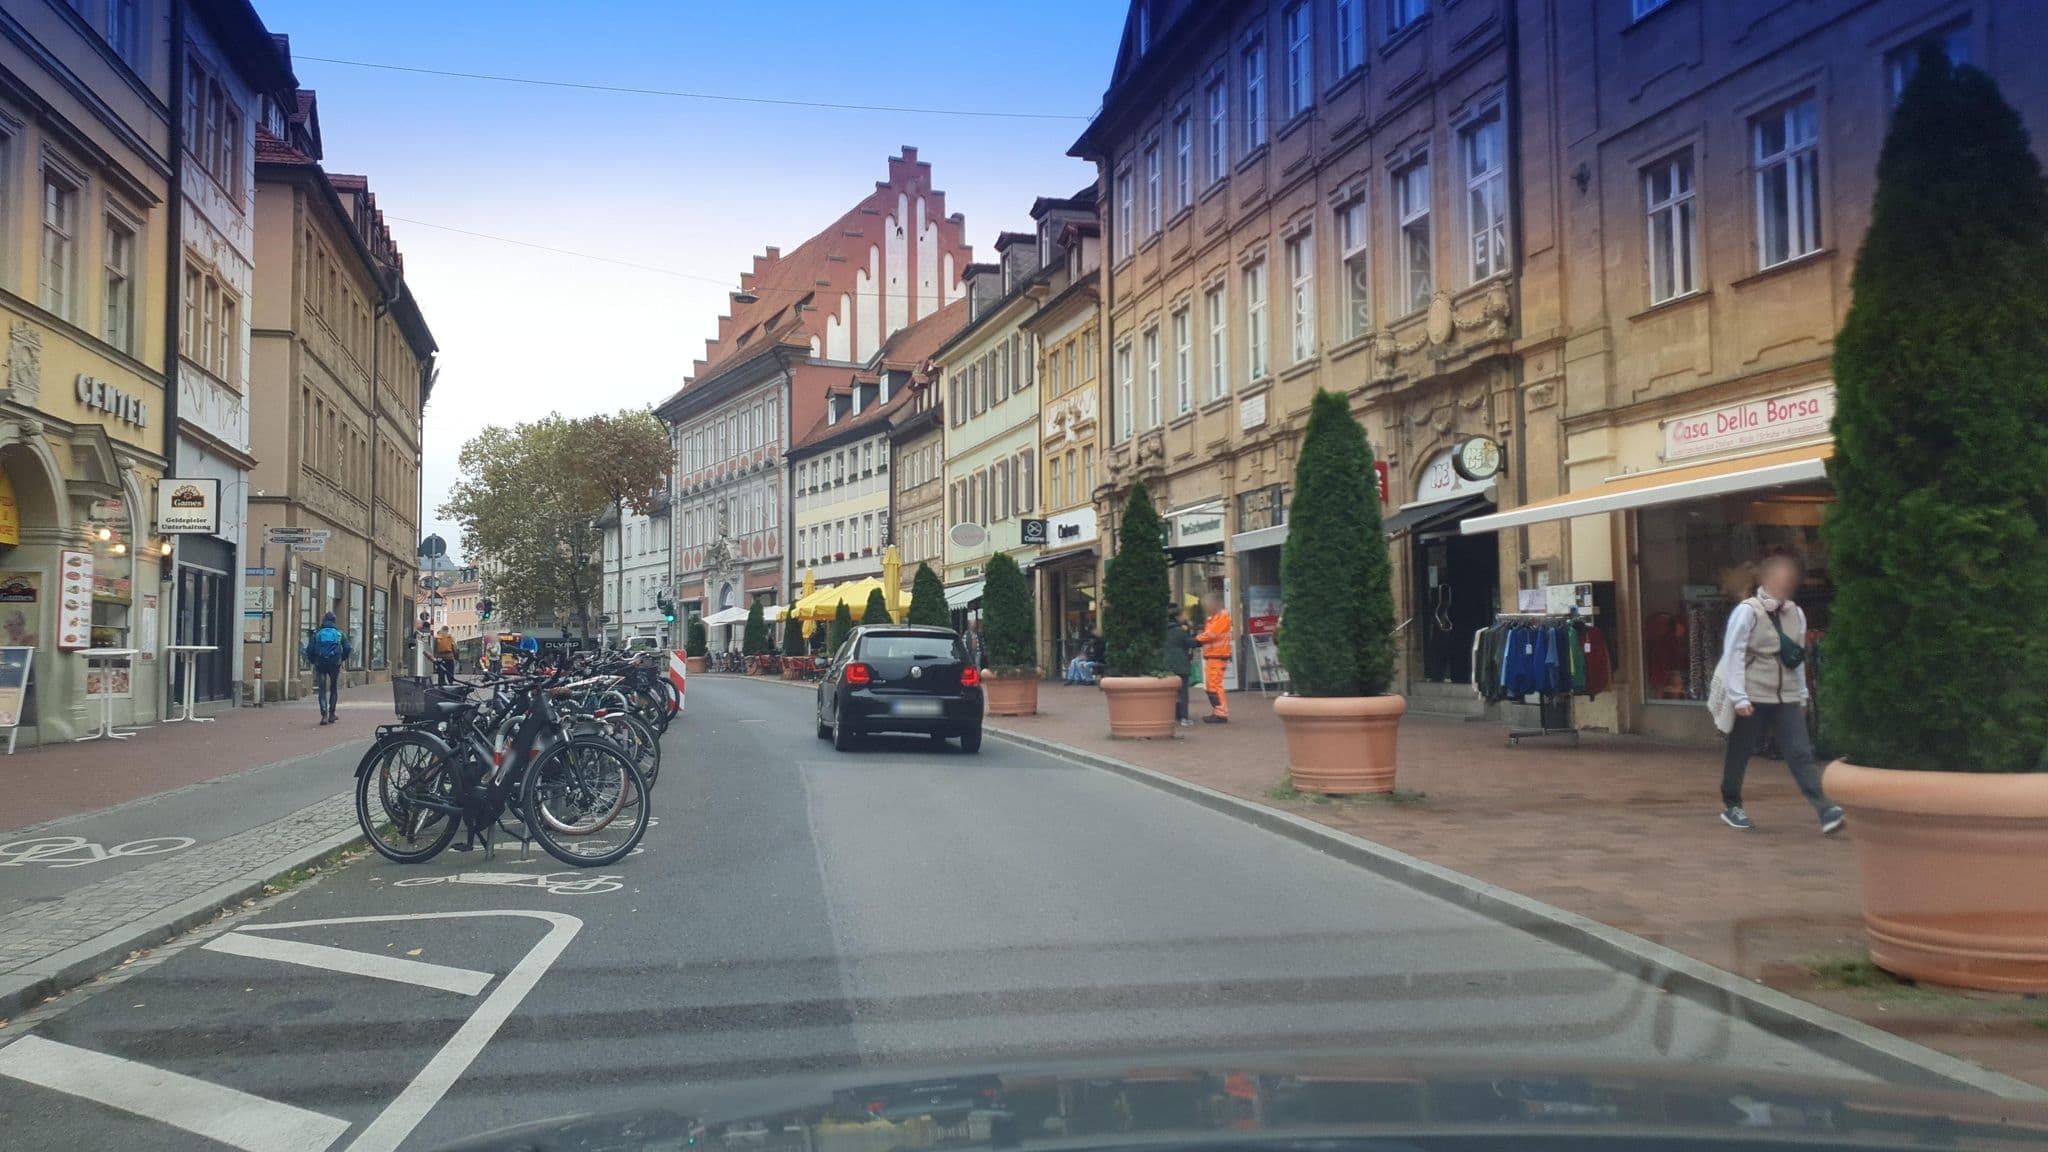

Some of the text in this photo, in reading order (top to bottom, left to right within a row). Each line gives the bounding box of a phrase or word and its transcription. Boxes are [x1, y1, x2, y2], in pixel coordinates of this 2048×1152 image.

[77, 373, 149, 427] CENTER
[1673, 399, 1819, 442] Casa Della Borsa
[174, 498, 202, 506] Games
[545, 641, 580, 649] OLYMP
